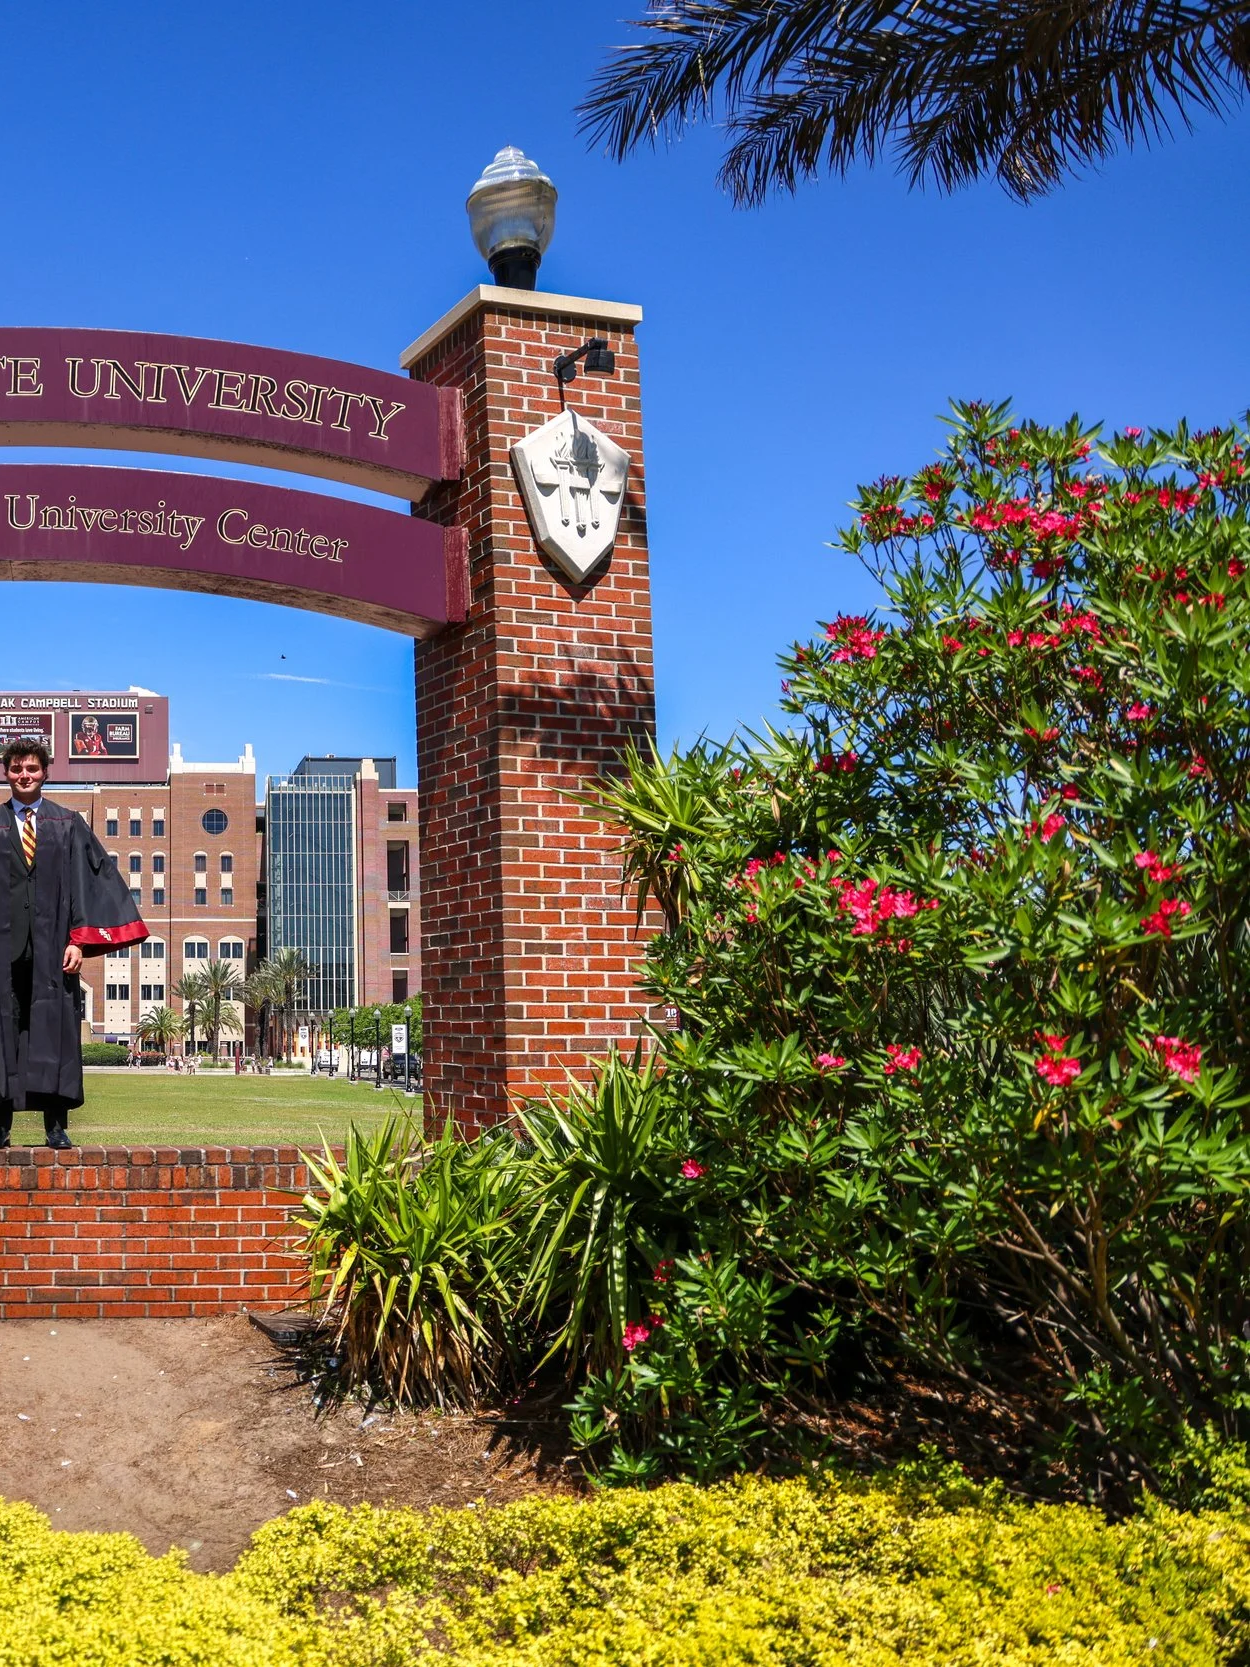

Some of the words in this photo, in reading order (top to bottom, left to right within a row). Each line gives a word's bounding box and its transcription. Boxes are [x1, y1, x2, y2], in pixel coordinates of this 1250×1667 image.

[65, 358, 406, 440] UNIVERSITY
[4, 495, 205, 549] University
[216, 508, 349, 562] Center
[21, 698, 81, 708] CAMPBELL
[87, 698, 139, 708] STADIUM
